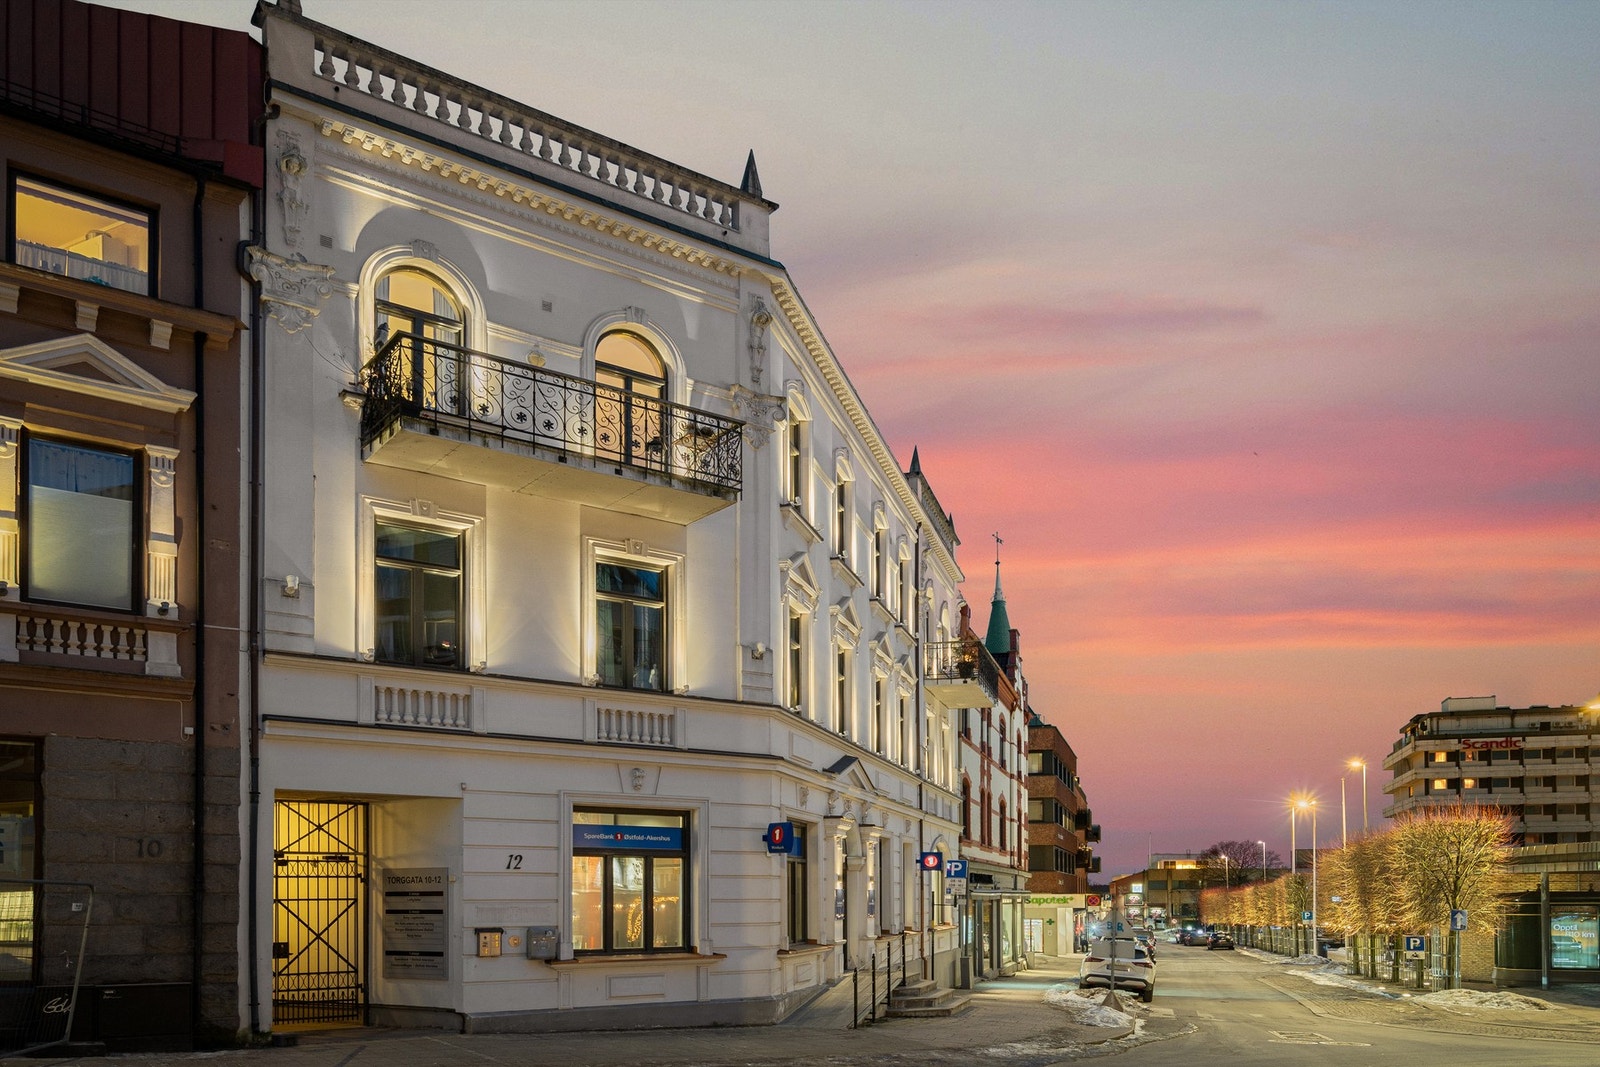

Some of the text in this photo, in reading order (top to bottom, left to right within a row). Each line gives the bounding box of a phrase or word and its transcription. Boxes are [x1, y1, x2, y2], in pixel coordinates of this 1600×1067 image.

[1462, 737, 1522, 749] Scandic
[583, 832, 614, 841] SpareBank
[623, 834, 671, 842] Østfold-Akershus
[774, 828, 780, 841] 1
[137, 838, 162, 858] 10
[505, 854, 523, 869] 12
[951, 862, 962, 876] P
[387, 875, 442, 884] TORGGATA 10-12
[1304, 912, 1311, 920] P
[1410, 937, 1420, 950] P
